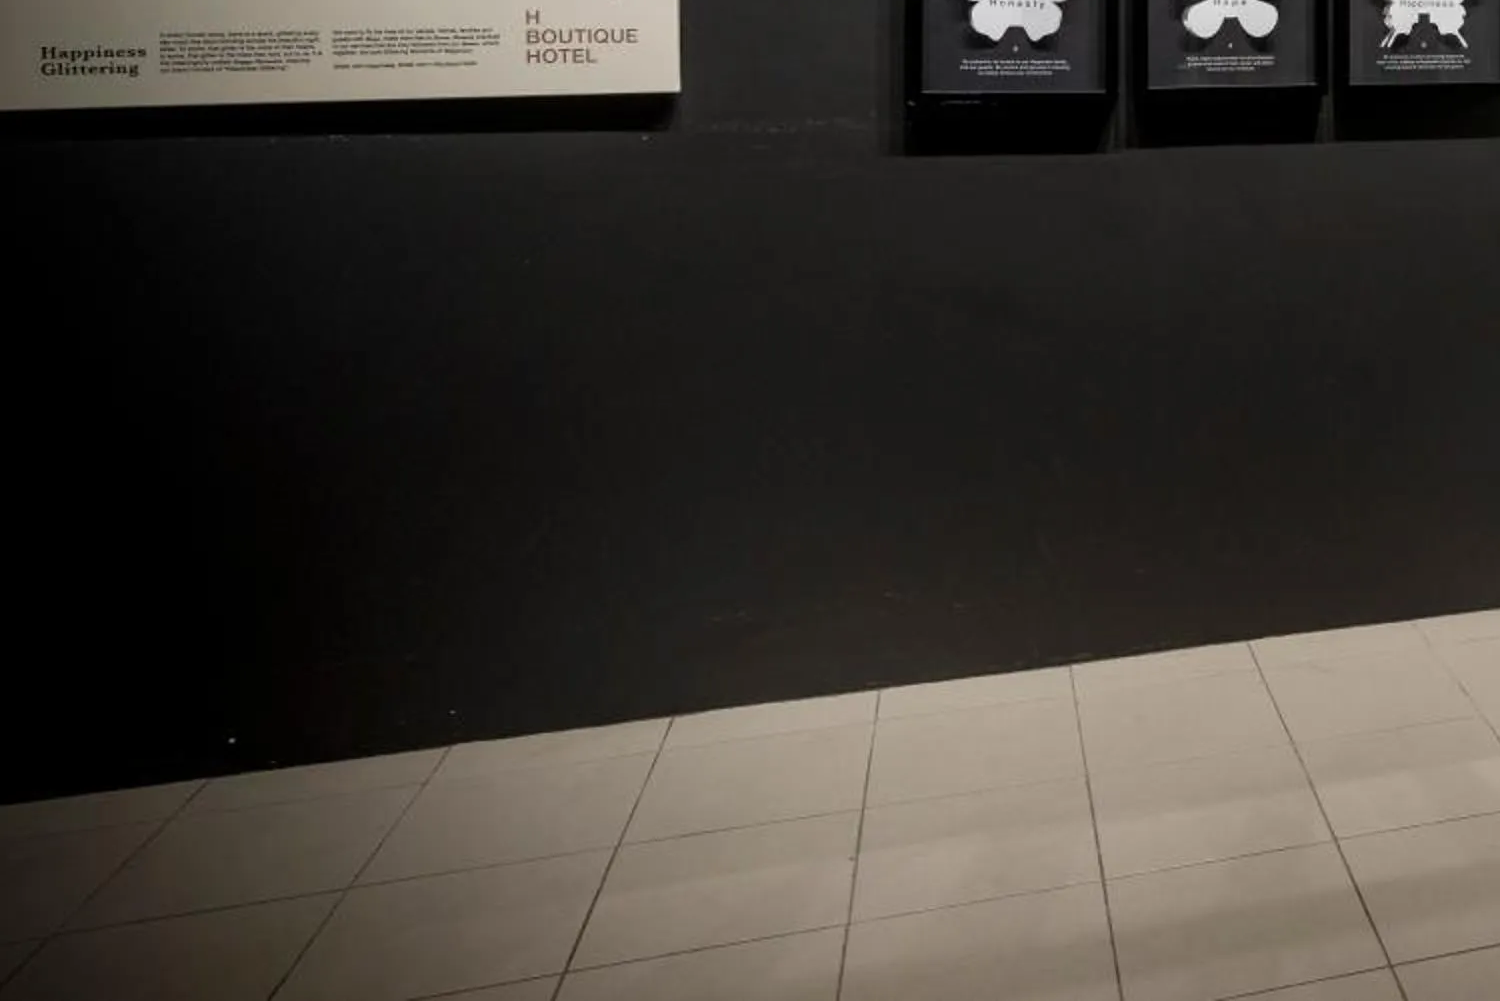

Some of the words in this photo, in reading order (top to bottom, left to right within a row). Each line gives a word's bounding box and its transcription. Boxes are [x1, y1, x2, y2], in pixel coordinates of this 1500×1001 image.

[526, 9, 540, 24] H
[527, 28, 639, 44] BOUTIQUE
[41, 45, 147, 62] Happiness
[527, 49, 598, 64] HOTEL
[41, 61, 139, 78] Glittering
